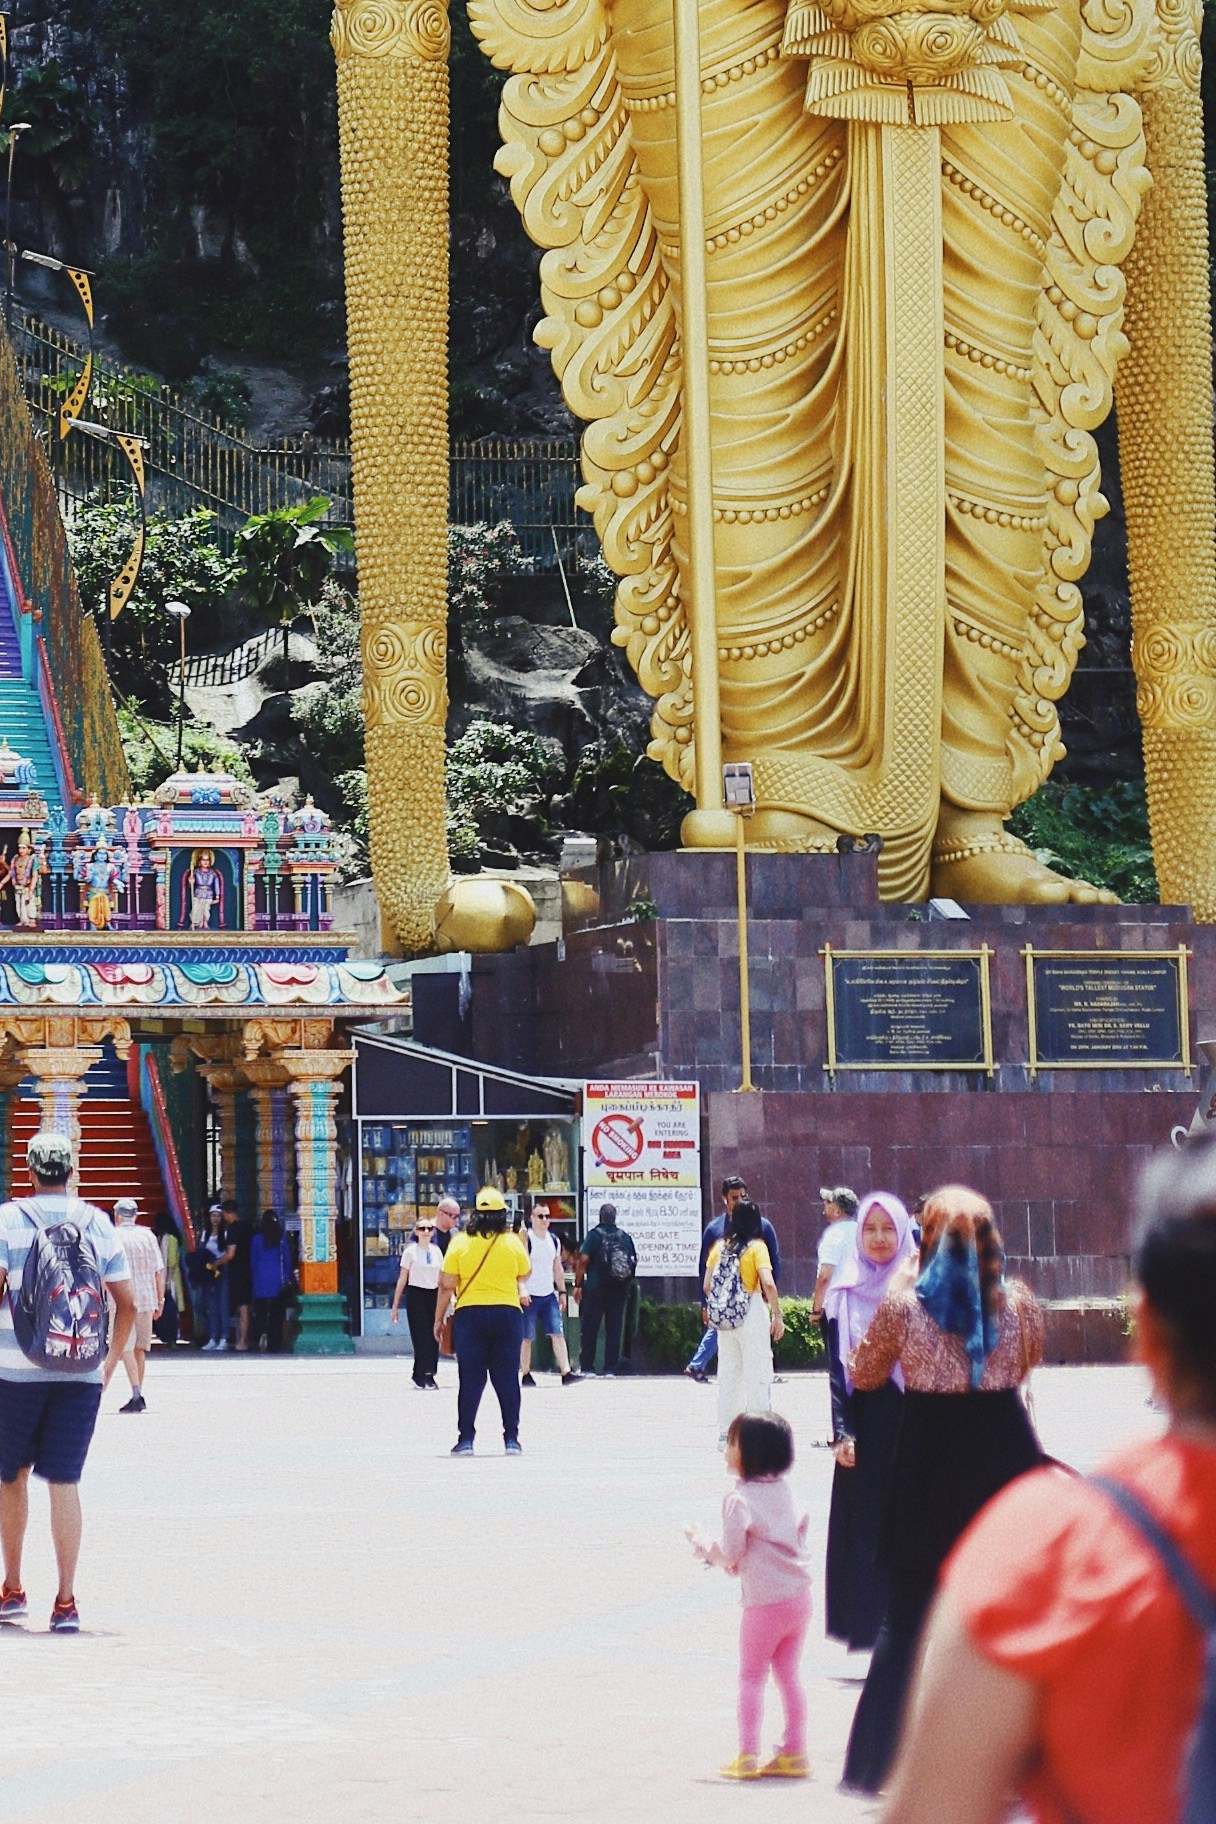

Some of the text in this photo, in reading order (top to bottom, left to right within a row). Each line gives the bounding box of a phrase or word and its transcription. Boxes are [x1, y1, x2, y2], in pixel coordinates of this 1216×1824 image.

[598, 1121, 638, 1160] NO SMOKING
[657, 1231, 680, 1239] GATE
[637, 1243, 673, 1251] OPENING
[640, 1255, 651, 1263] AM
[652, 1255, 660, 1263] TO
[685, 1255, 697, 1263] PM
